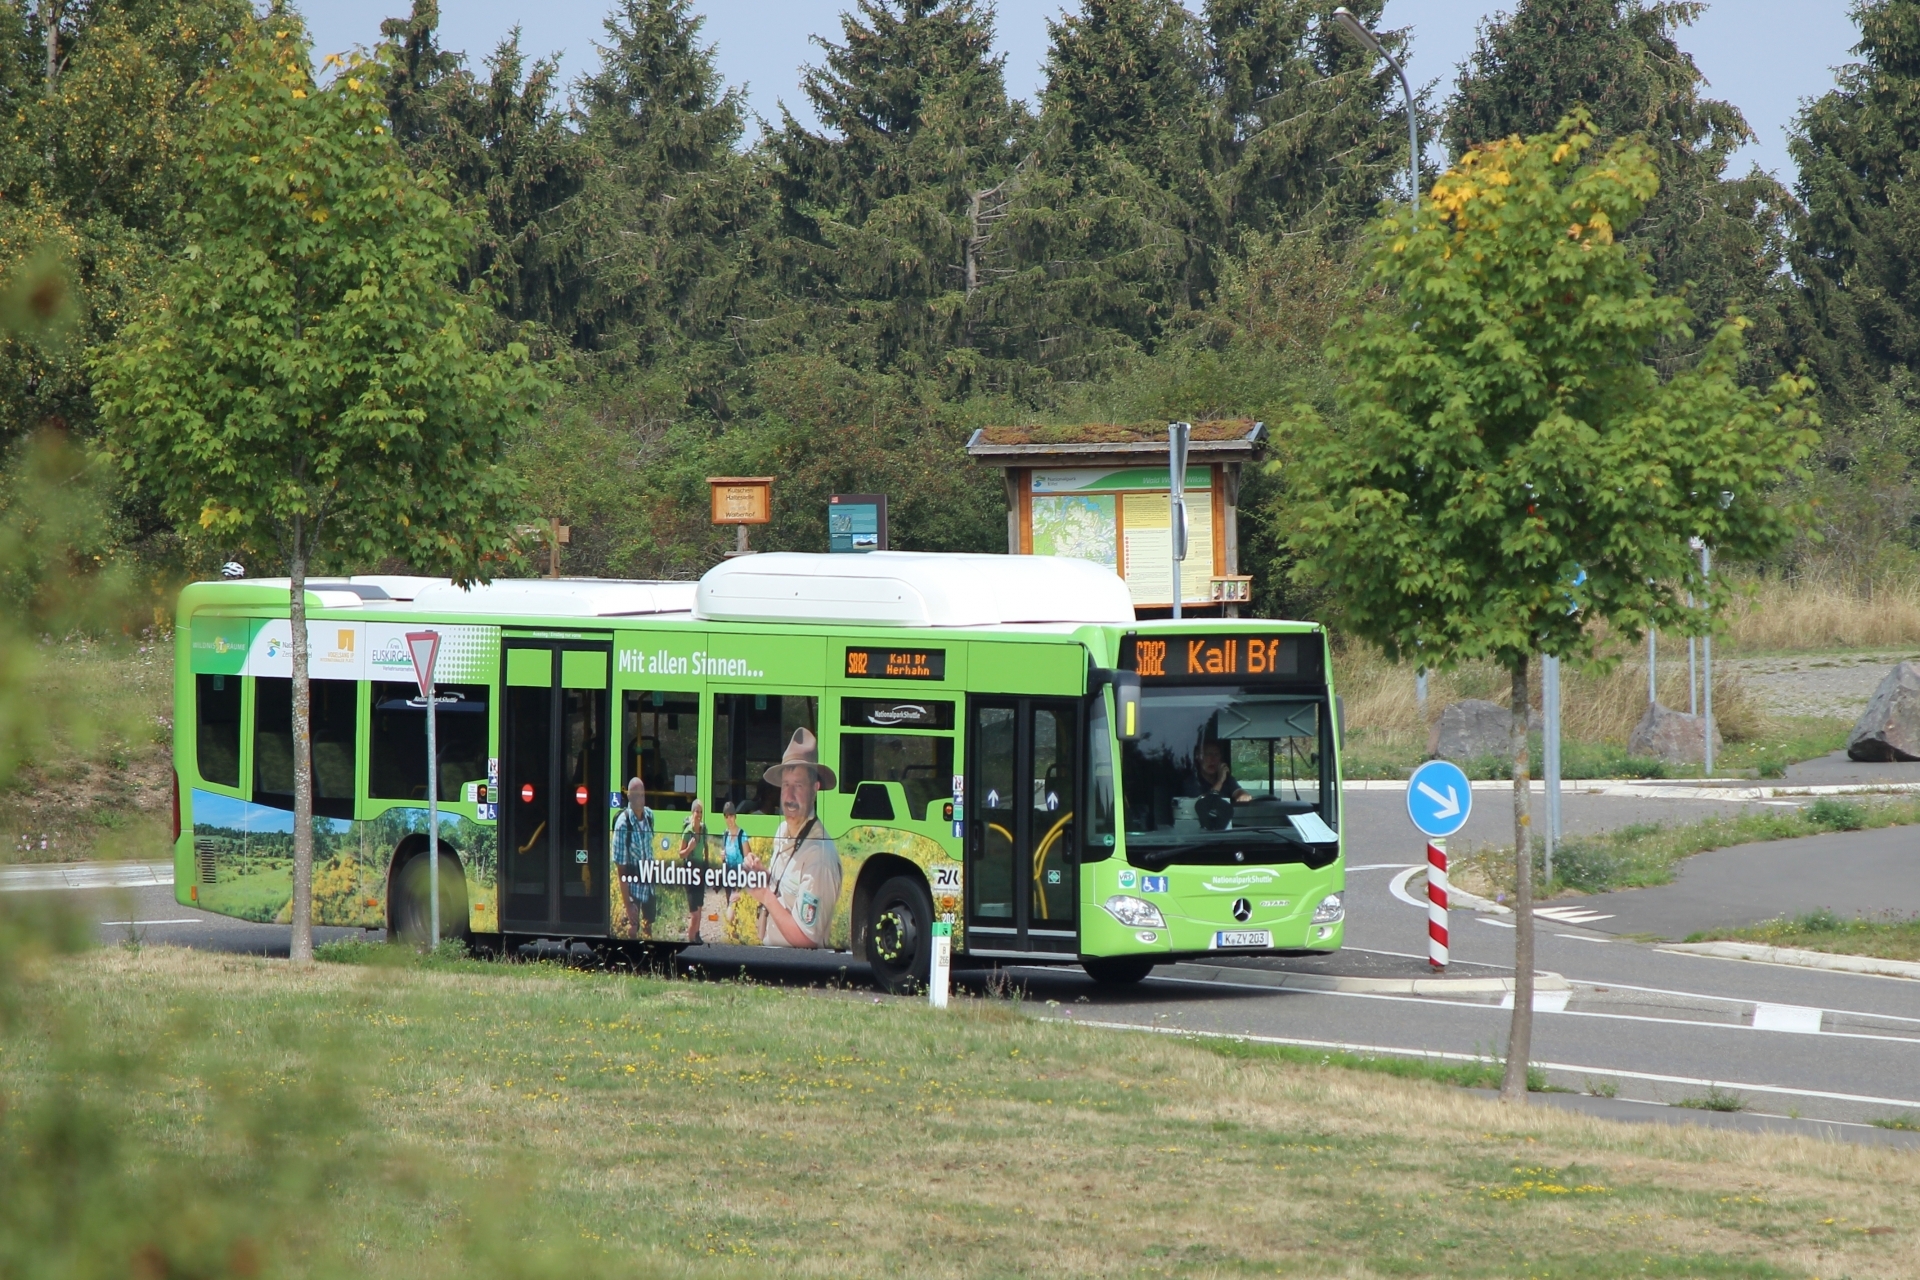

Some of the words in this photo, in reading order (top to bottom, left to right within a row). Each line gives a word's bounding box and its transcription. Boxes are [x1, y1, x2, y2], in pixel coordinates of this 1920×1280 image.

[372, 650, 412, 661] EUSKIRCHE
[890, 653, 911, 665] Kall
[914, 654, 927, 665] Bf
[1188, 640, 1237, 673] Kall
[1248, 639, 1279, 673] Bf
[618, 649, 645, 673] Mit
[648, 650, 687, 675] allen
[691, 651, 764, 678] Sinnen...
[886, 664, 930, 676] Herhahn
[621, 859, 701, 886] ...Wildnis
[704, 863, 768, 889] erleben
[942, 912, 955, 924] 203
[1225, 933, 1232, 945] K
[1236, 934, 1248, 945] ZY
[1249, 933, 1265, 944] 203
